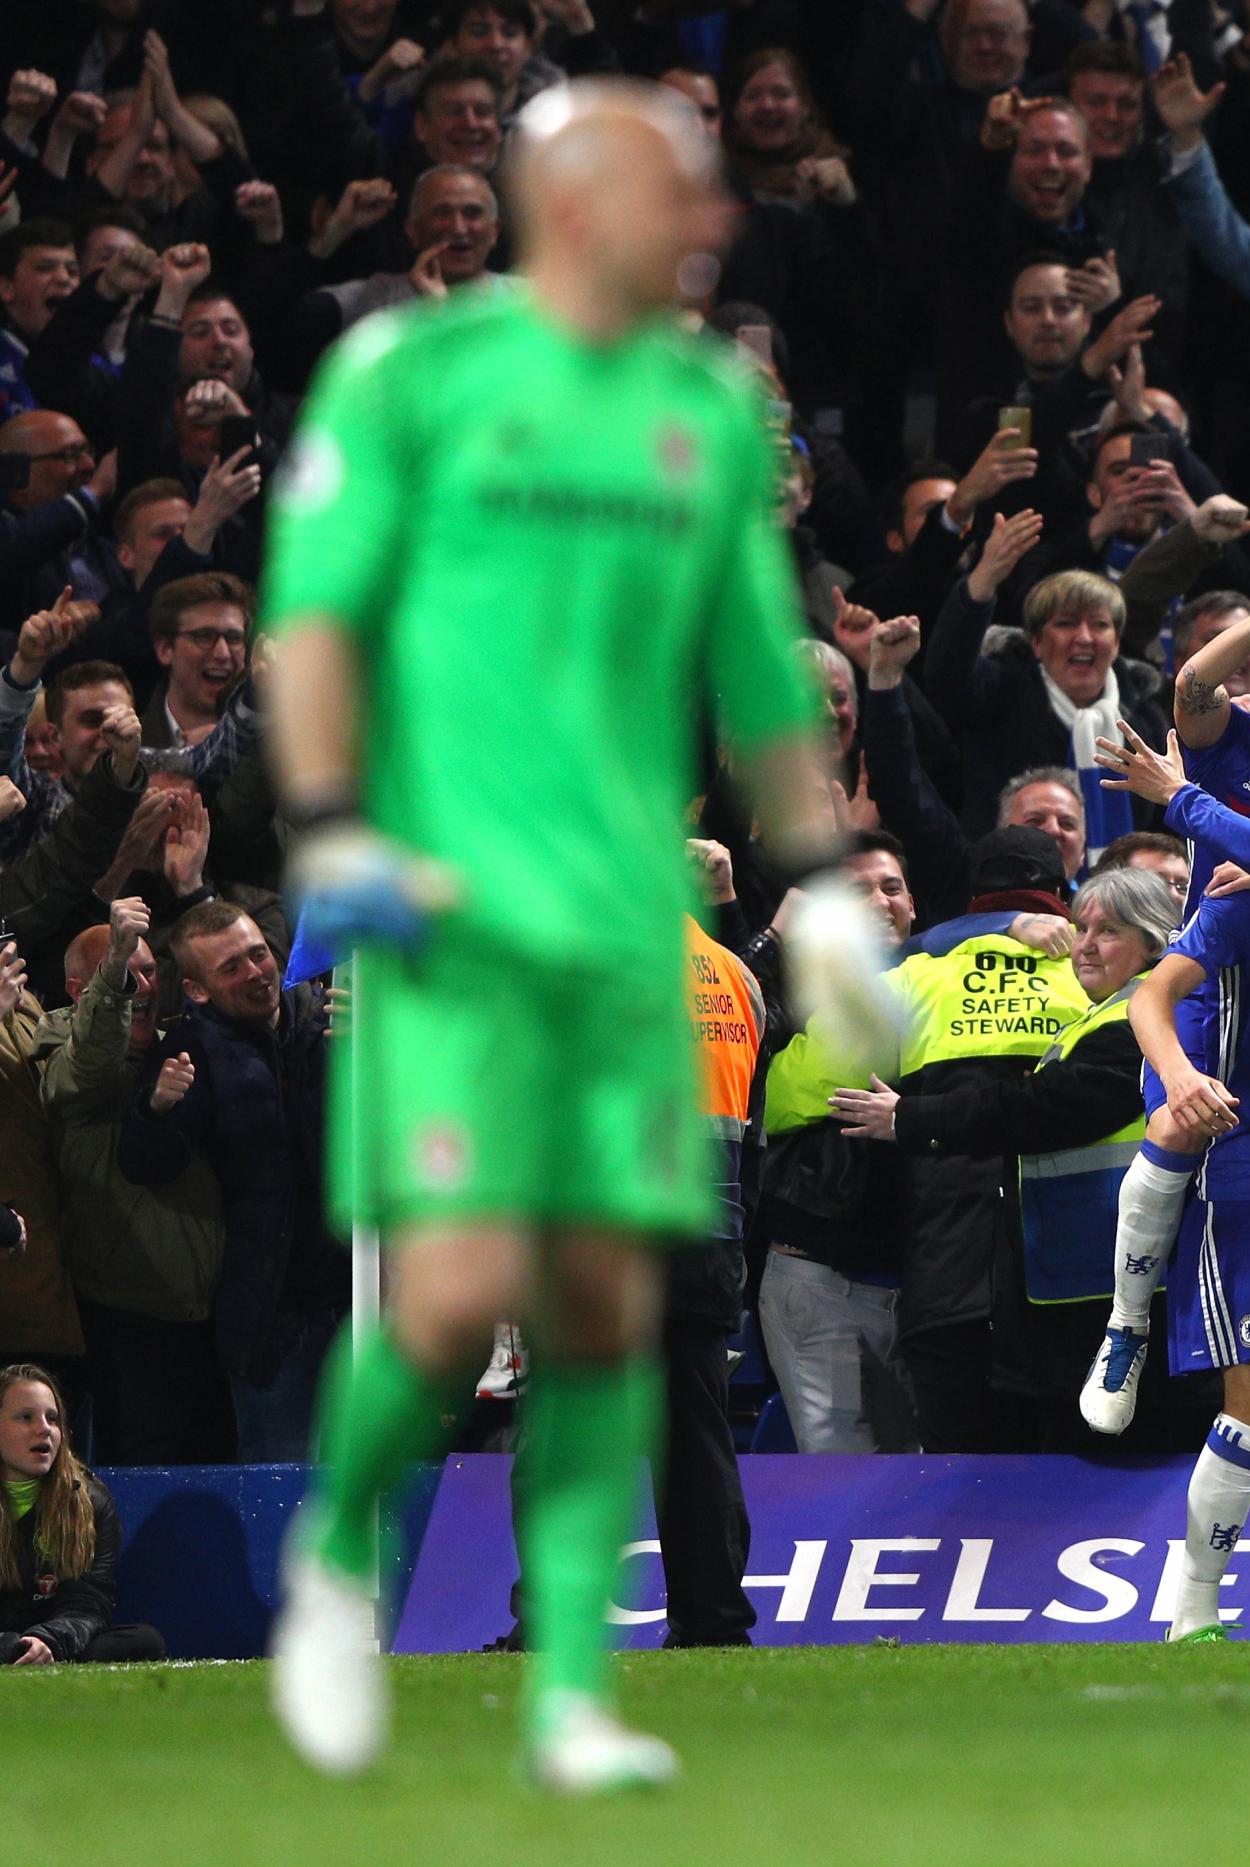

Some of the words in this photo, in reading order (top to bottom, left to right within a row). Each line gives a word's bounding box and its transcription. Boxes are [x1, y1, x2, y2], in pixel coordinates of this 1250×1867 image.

[694, 994, 734, 1015] SENIOR
[962, 997, 1050, 1014] SAFETY
[692, 1021, 747, 1044] UPERVISOR
[950, 1017, 1061, 1036] STEWARD
